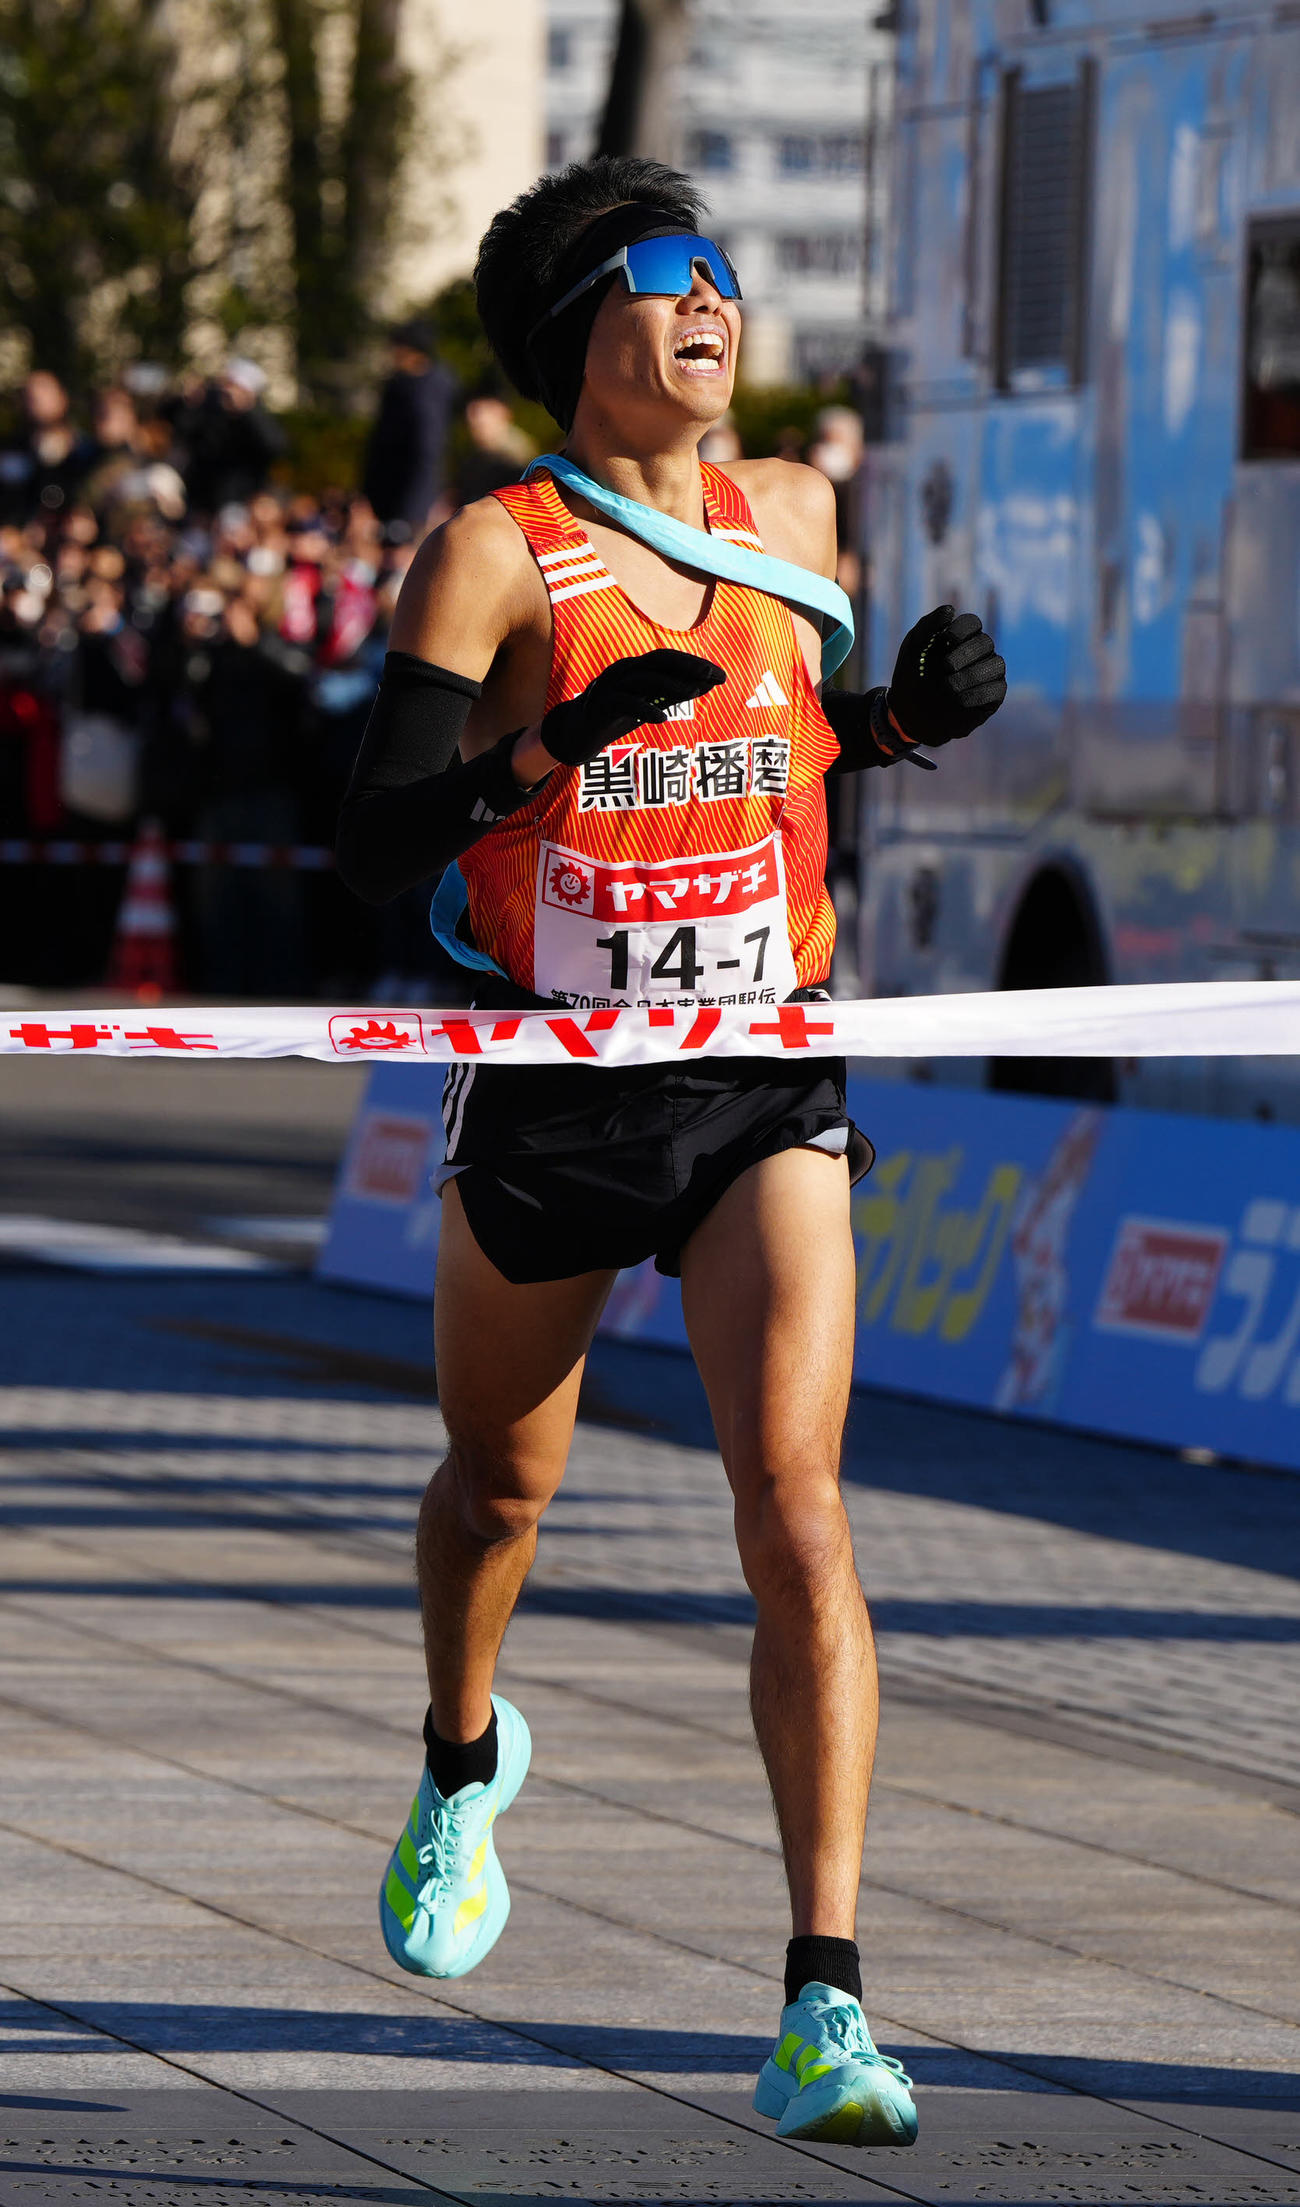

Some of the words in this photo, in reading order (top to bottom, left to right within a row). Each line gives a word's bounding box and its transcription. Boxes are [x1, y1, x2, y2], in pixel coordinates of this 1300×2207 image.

[580, 738, 789, 810] 黒崎播磨
[605, 859, 767, 911] ヤマザキ
[596, 925, 771, 991] 14-7
